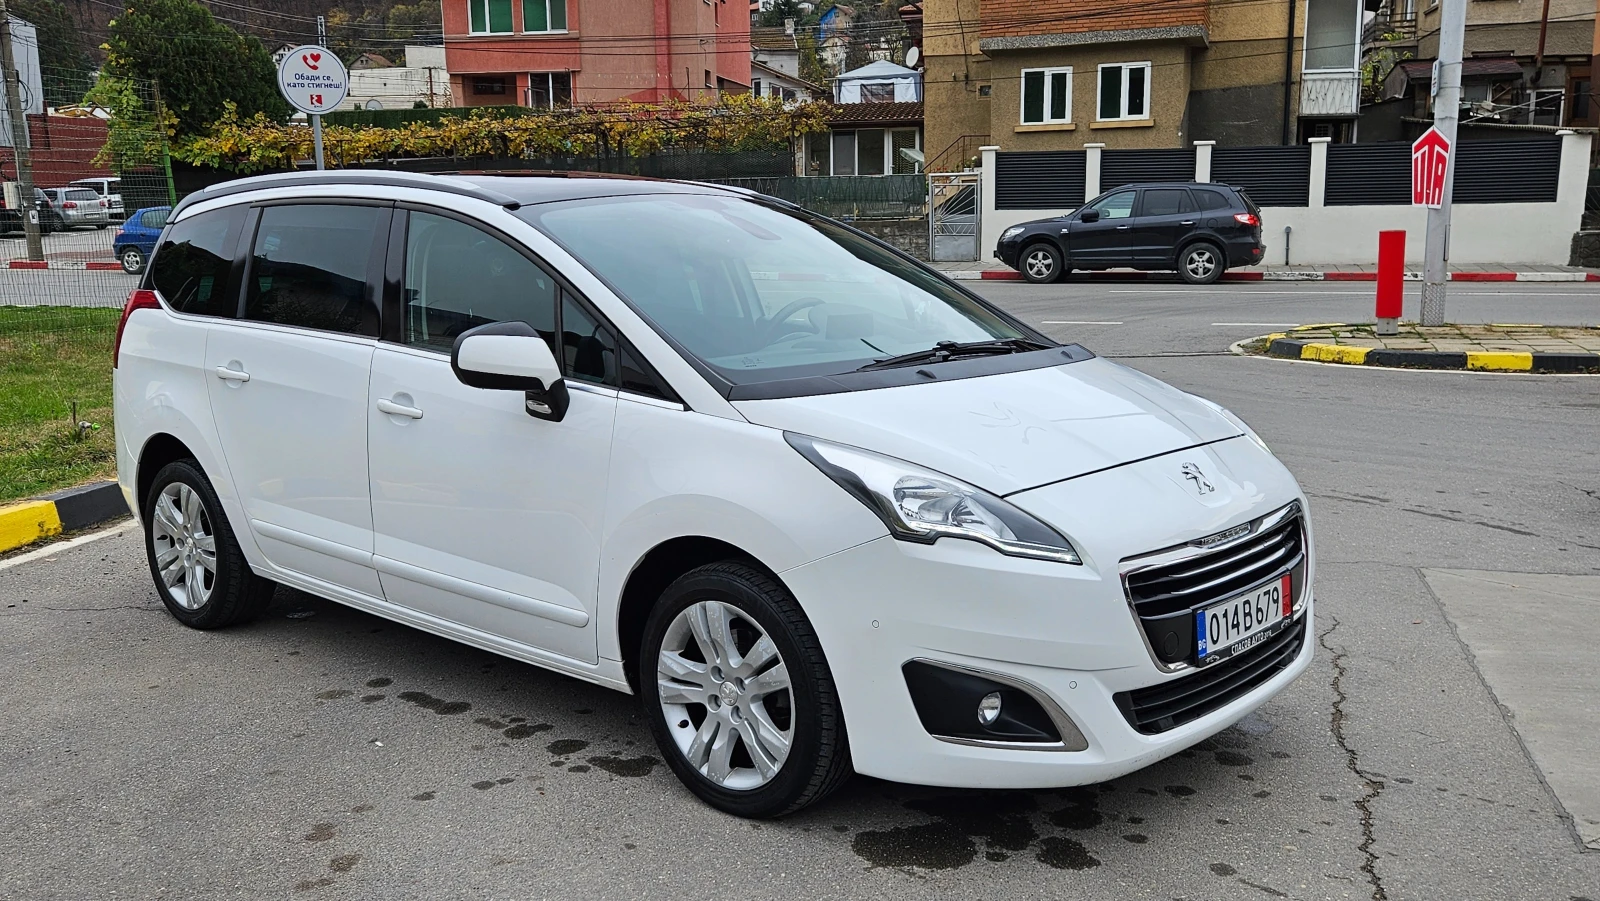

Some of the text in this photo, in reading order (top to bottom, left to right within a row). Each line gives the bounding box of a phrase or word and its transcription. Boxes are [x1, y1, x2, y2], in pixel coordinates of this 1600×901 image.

[294, 73, 320, 81] Обади
[1198, 639, 1206, 651] BG
[1231, 638, 1251, 654] СПАСОВ
